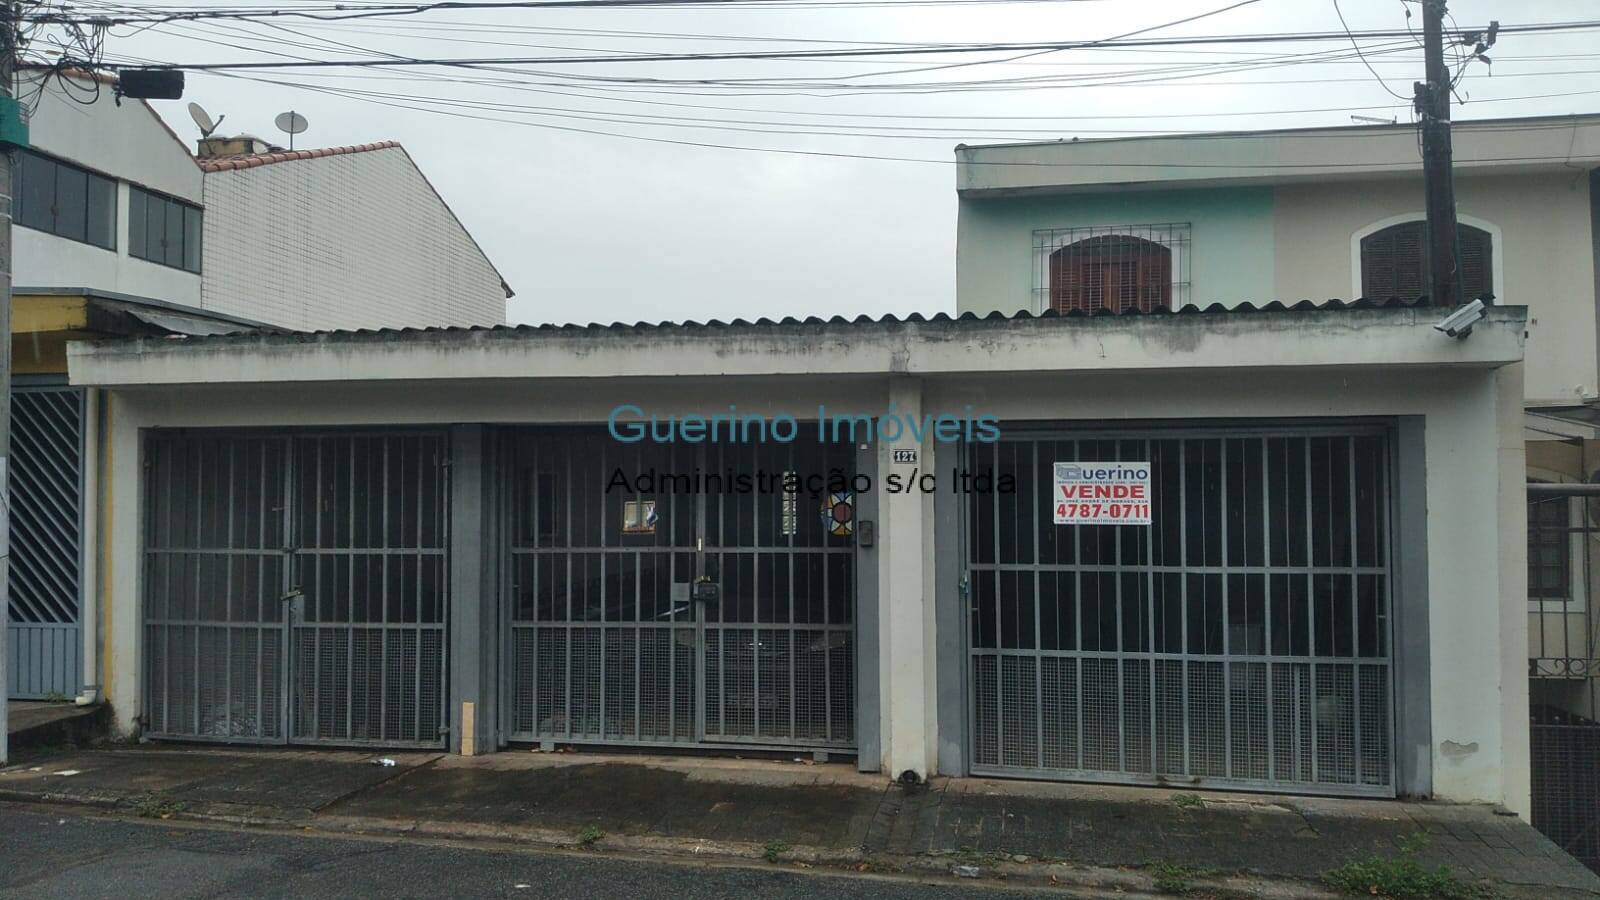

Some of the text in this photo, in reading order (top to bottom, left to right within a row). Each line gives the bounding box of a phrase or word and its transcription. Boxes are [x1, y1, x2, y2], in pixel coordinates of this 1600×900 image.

[895, 451, 914, 462] 127
[1061, 485, 1144, 498] VENDE
[1056, 504, 1148, 518] 4787-0711
